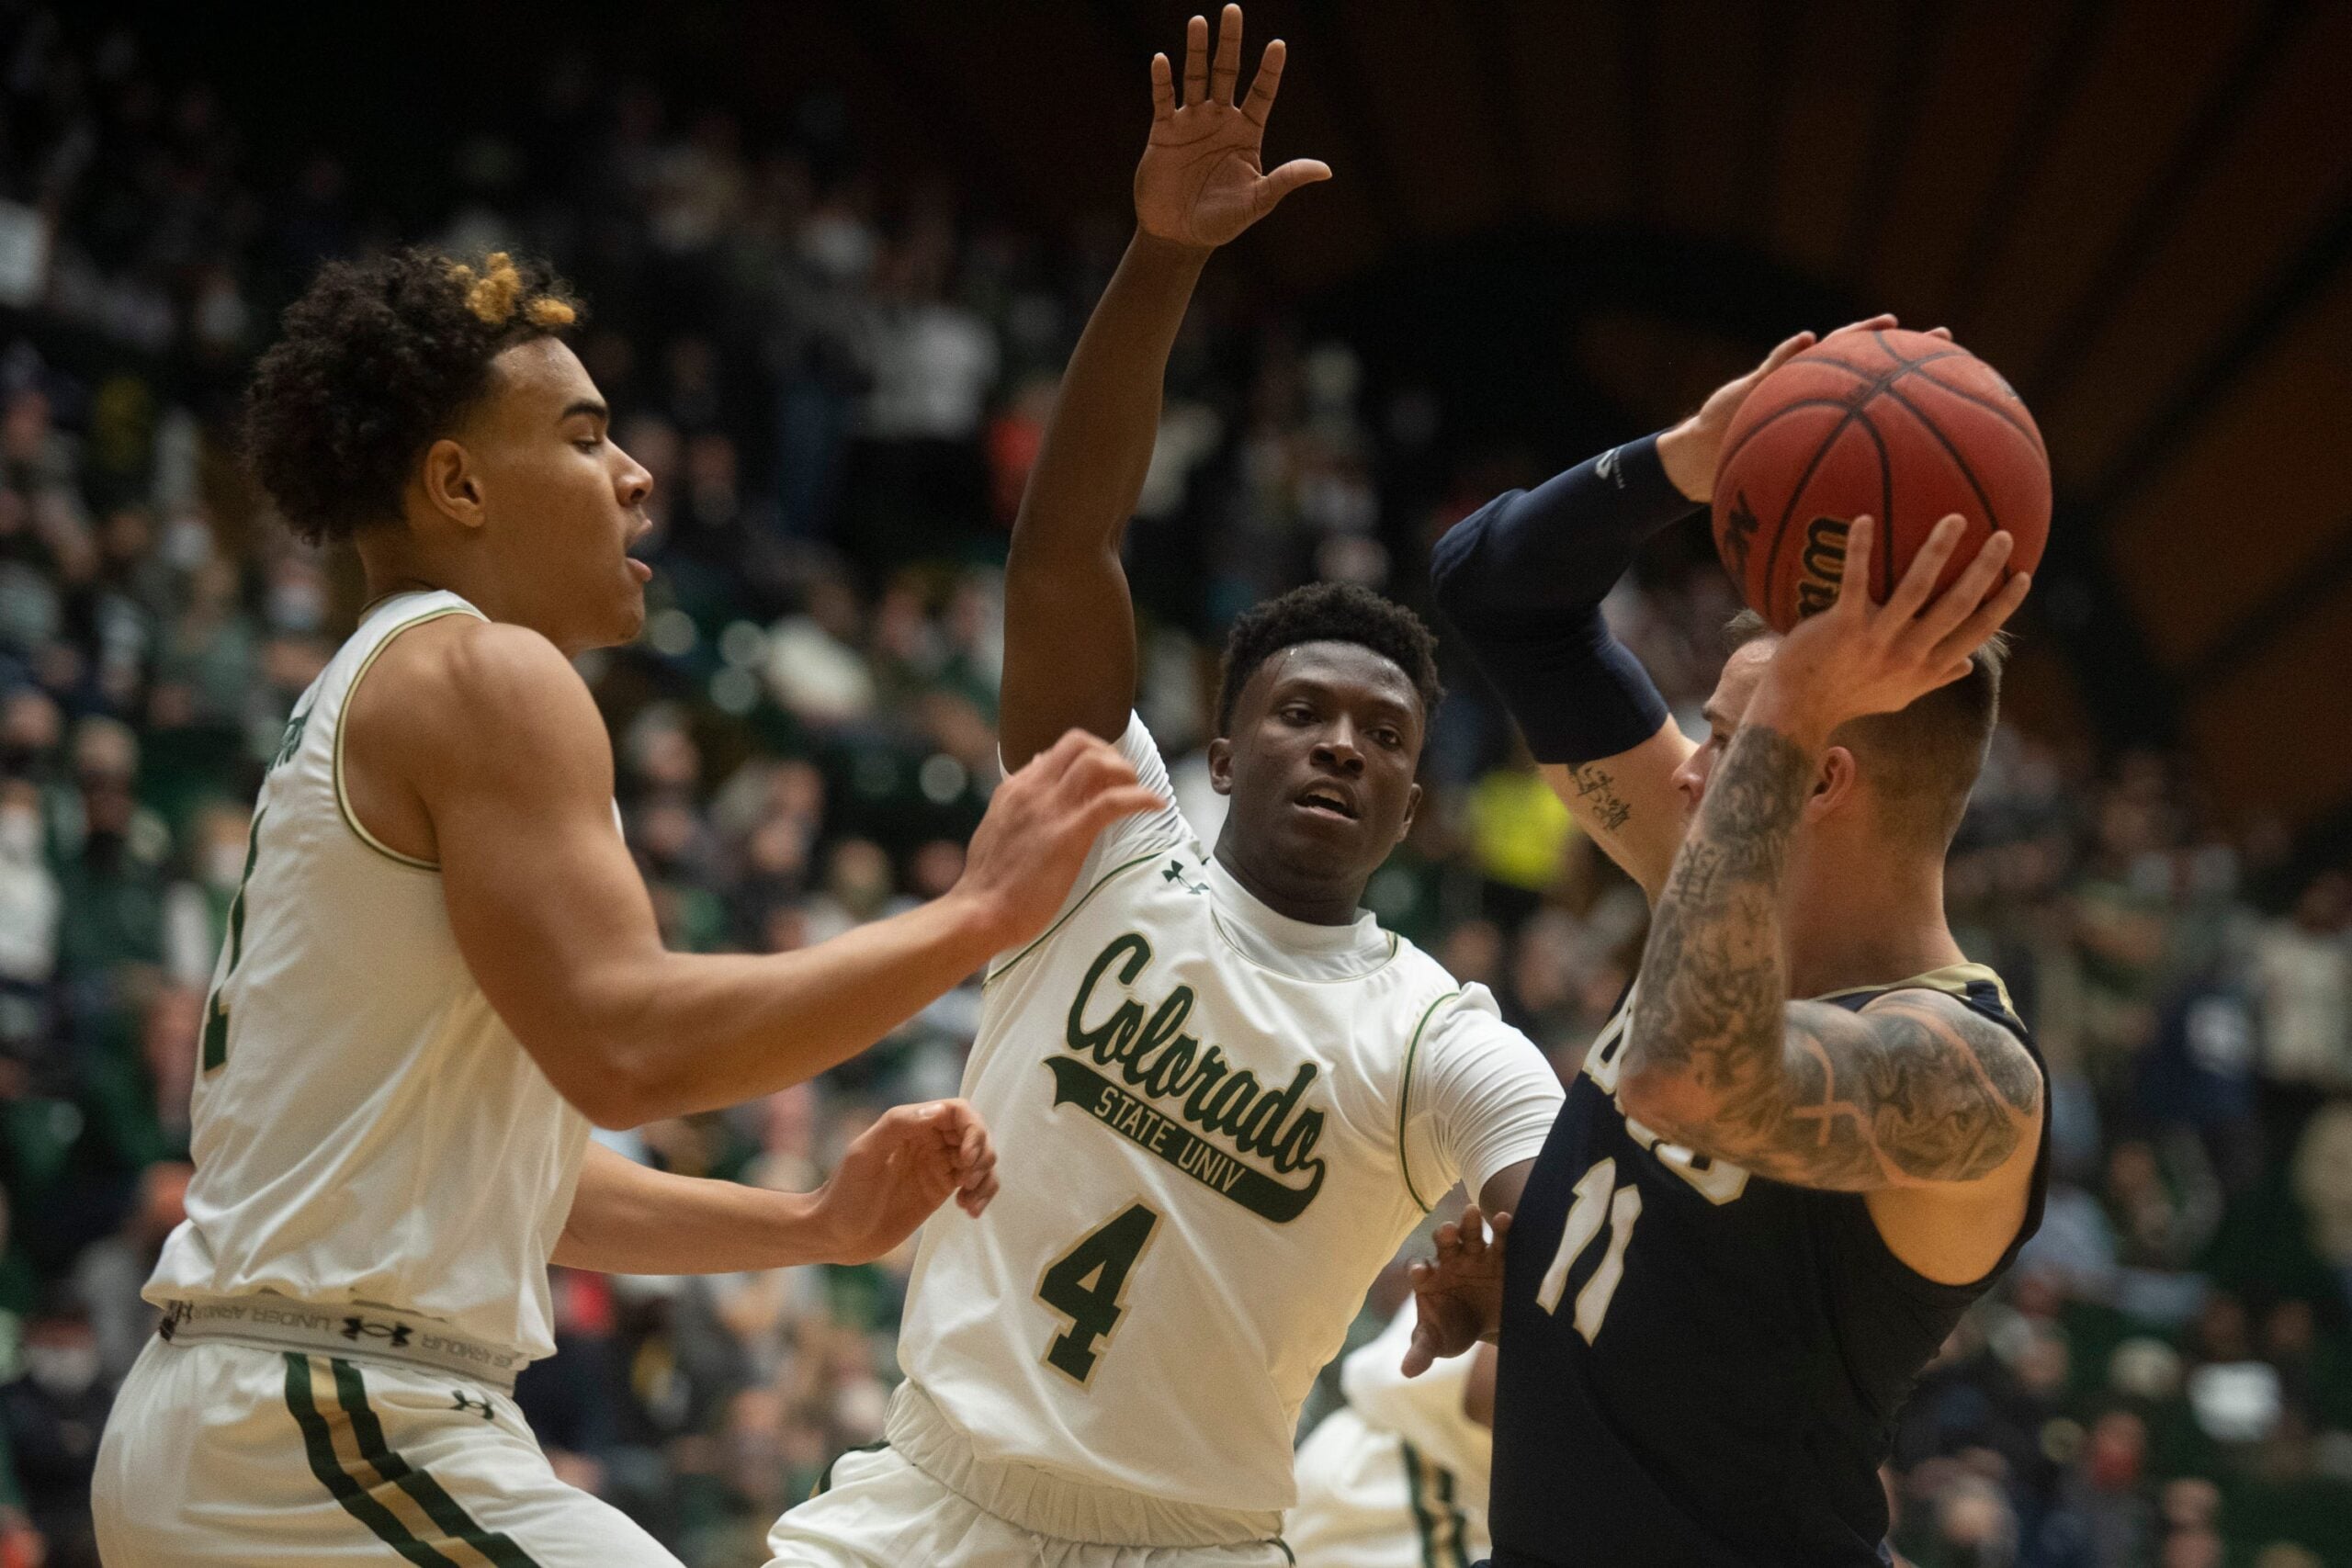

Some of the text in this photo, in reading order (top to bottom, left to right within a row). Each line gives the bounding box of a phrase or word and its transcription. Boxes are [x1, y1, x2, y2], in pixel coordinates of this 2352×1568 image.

[1064, 931, 1327, 1175] Colorado
[1093, 1086, 1246, 1194] STATE UNIV
[252, 1308, 331, 1332] UNDER
[1035, 1200, 1161, 1388] 4
[1535, 1156, 1643, 1348] 11
